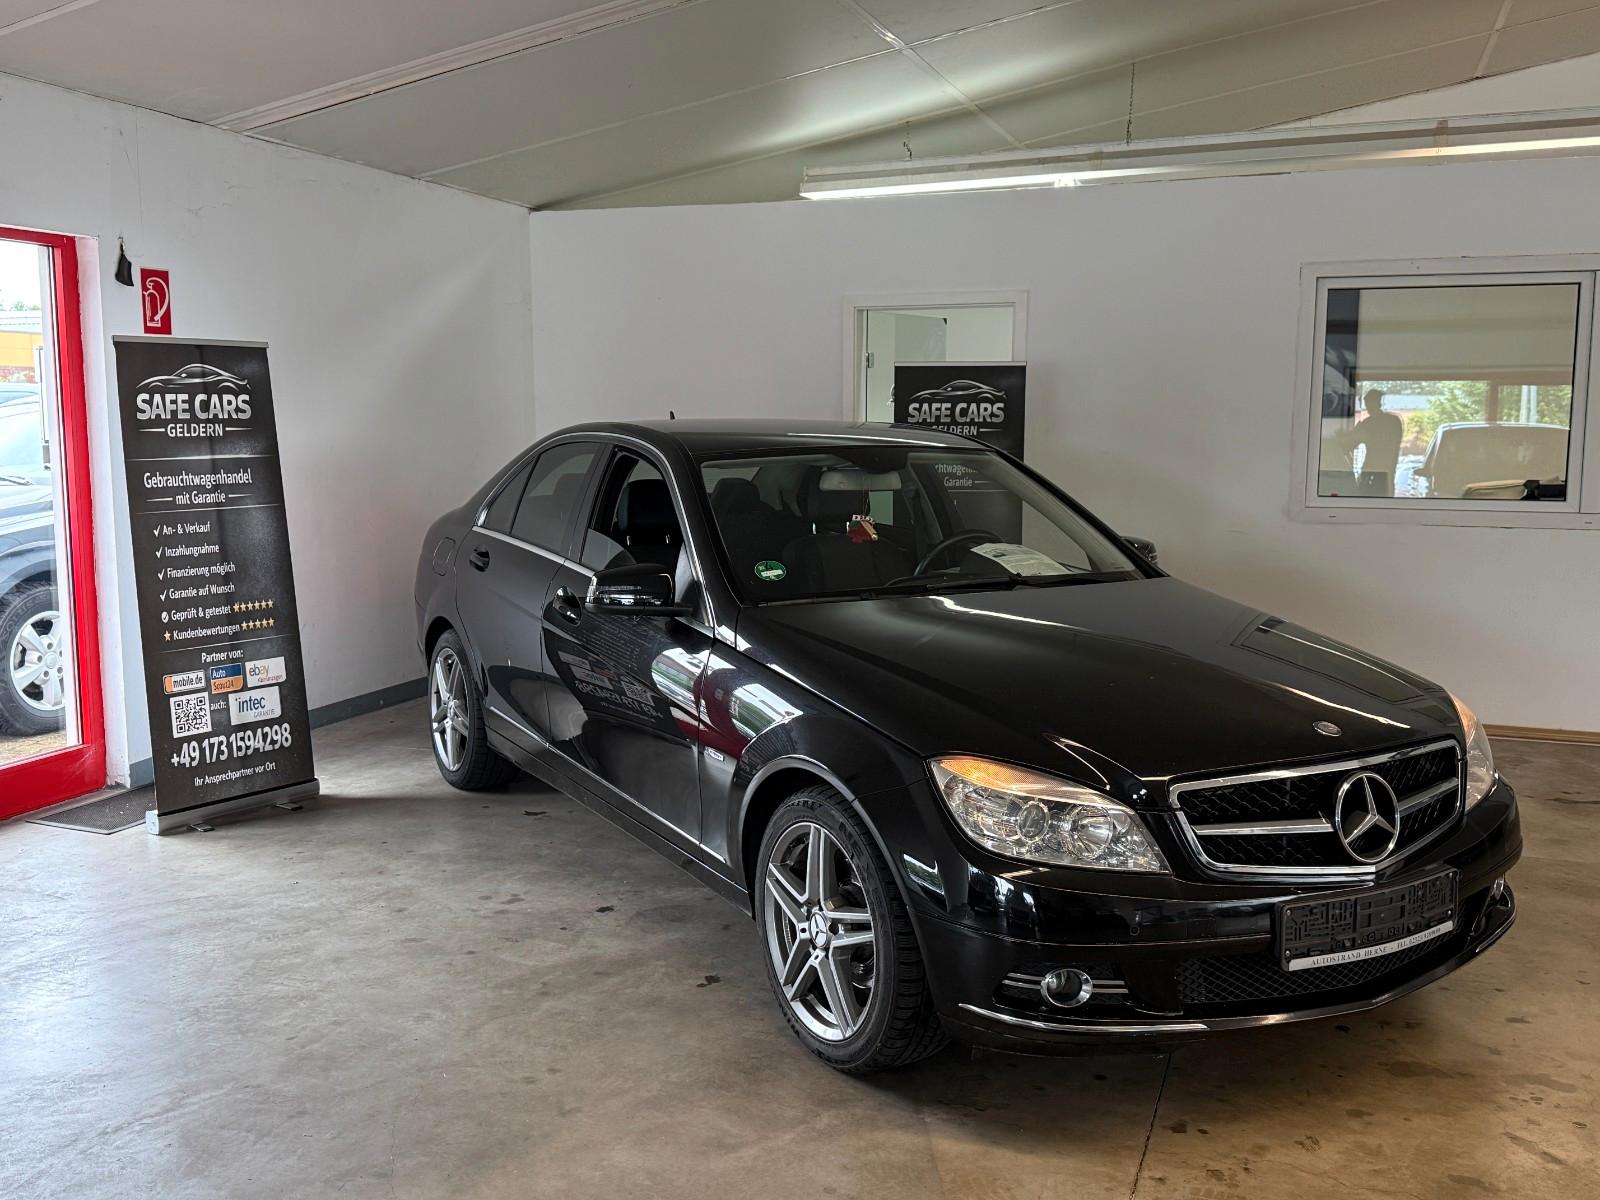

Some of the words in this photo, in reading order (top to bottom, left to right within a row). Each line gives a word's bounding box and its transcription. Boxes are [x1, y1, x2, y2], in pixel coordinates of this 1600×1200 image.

[136, 393, 191, 420] SAFE
[194, 393, 252, 420] CARS
[907, 402, 951, 423] SAFE
[954, 402, 1005, 423] CARS
[167, 423, 223, 437] GELDERN
[143, 468, 252, 489] Gebrauchtwagenhandel
[943, 476, 973, 487] Garantie
[175, 491, 190, 504] mit
[191, 489, 226, 504] Garantie
[162, 524, 176, 536] An-
[177, 523, 184, 535] &
[184, 521, 211, 534] Verkauf
[165, 542, 220, 557] Inzahlungnahme
[167, 565, 210, 578] Finanzierung
[210, 561, 236, 576] möglich
[169, 586, 197, 599] Garantie
[198, 584, 209, 596] auf
[209, 581, 235, 595] Wunsch
[171, 606, 197, 621] Geprüft
[198, 607, 204, 617] &
[205, 604, 232, 618] getestet
[173, 623, 240, 641] Kundenbewertungen
[201, 651, 227, 663] Partner
[227, 649, 244, 660] von:
[212, 669, 226, 679] Auto
[248, 663, 270, 678] ebay
[172, 674, 203, 689] mobile.de
[213, 680, 235, 691] Scout24
[210, 699, 227, 711] auch:
[238, 694, 266, 713] intec
[253, 708, 276, 718] GARANTIE
[171, 741, 199, 768] +49
[202, 735, 229, 764] 173
[230, 723, 292, 758] 1594298
[194, 774, 203, 787] Ihr
[204, 765, 253, 785] Ansprechpartner
[254, 764, 264, 774] vor
[265, 761, 276, 772] Ort
